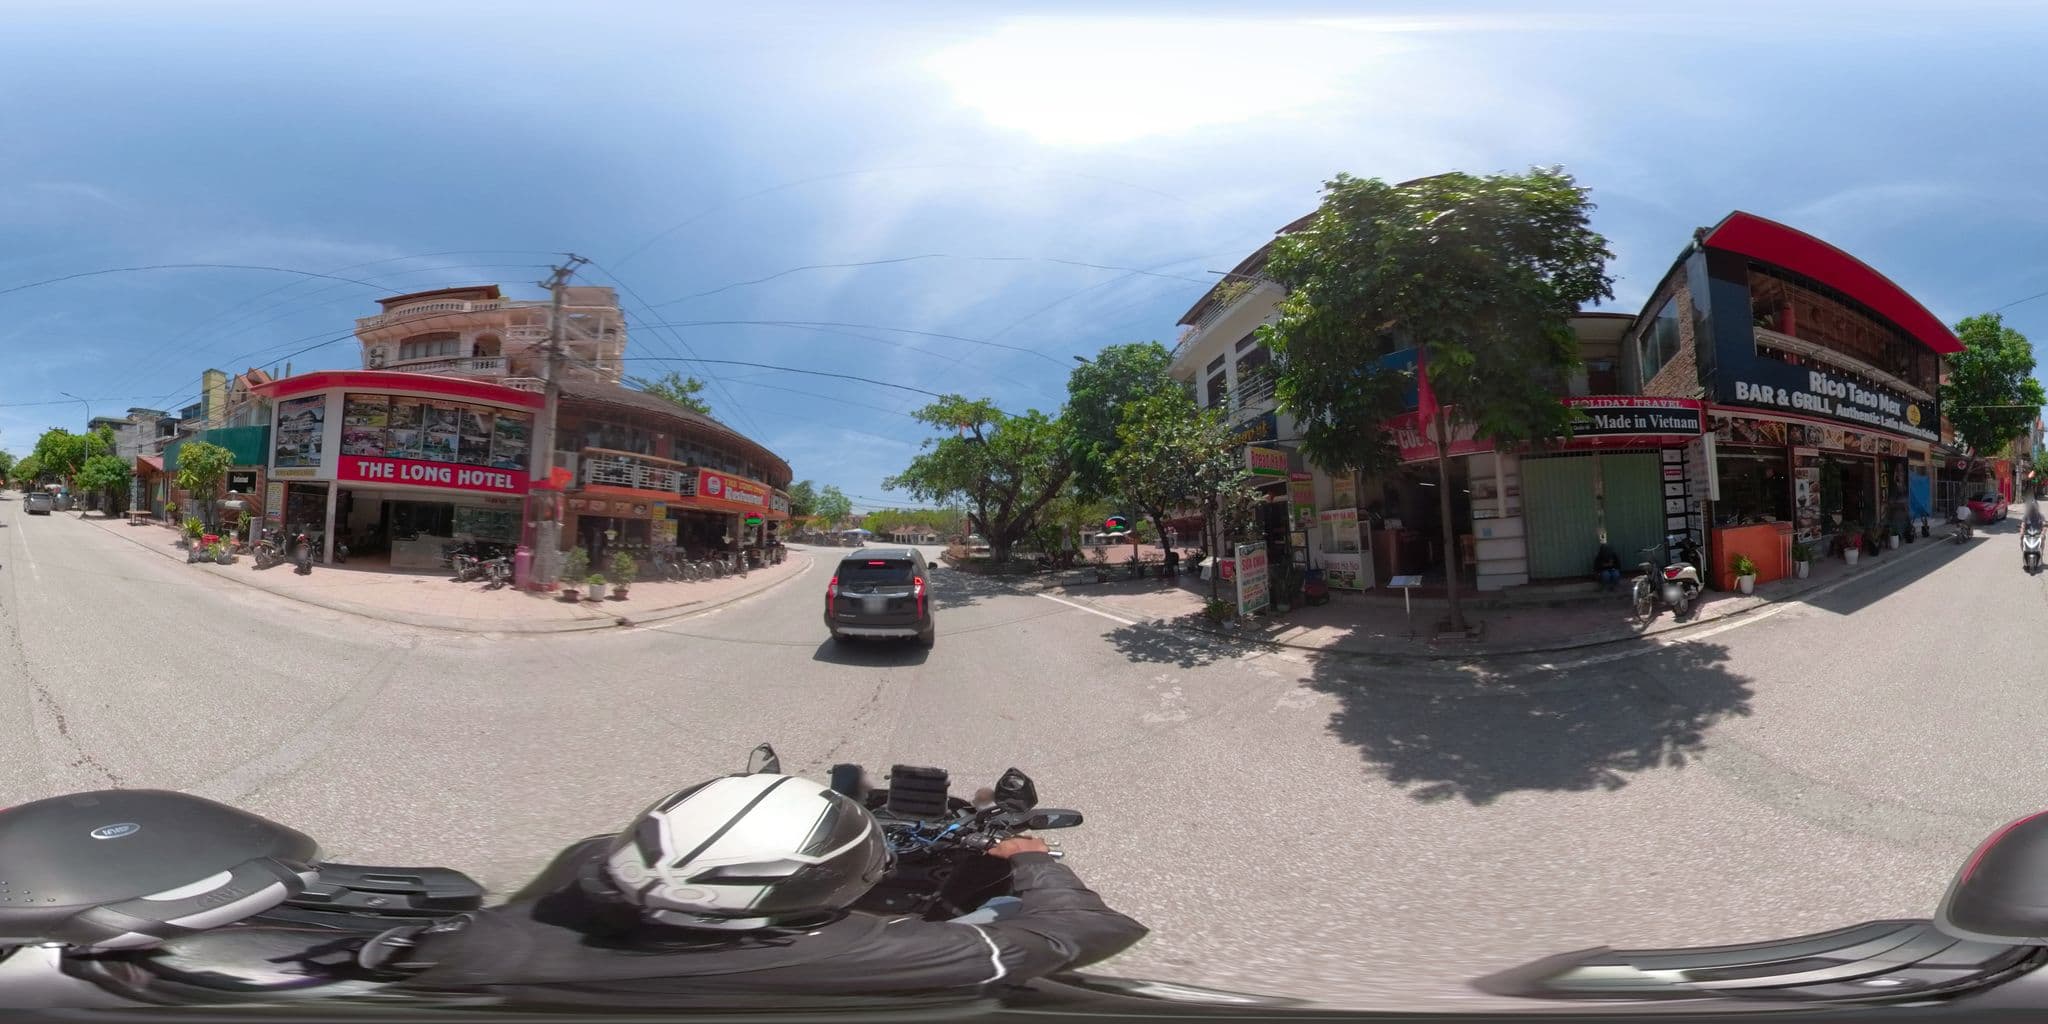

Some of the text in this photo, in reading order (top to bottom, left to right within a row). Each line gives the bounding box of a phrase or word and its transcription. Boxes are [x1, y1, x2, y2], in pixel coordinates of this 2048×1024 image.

[1570, 399, 1683, 408] HOLIDAY TRAVEL
[1735, 381, 1833, 414] BAR & GRILL
[1808, 370, 1901, 416] Rico Taco Mex
[1594, 414, 1631, 429] Made
[1634, 414, 1647, 428] in
[1649, 414, 1698, 429] Vietnam
[1835, 403, 1880, 424] Authentic
[1881, 415, 1899, 430] Latin
[358, 461, 514, 489] THE LONG HOTEL
